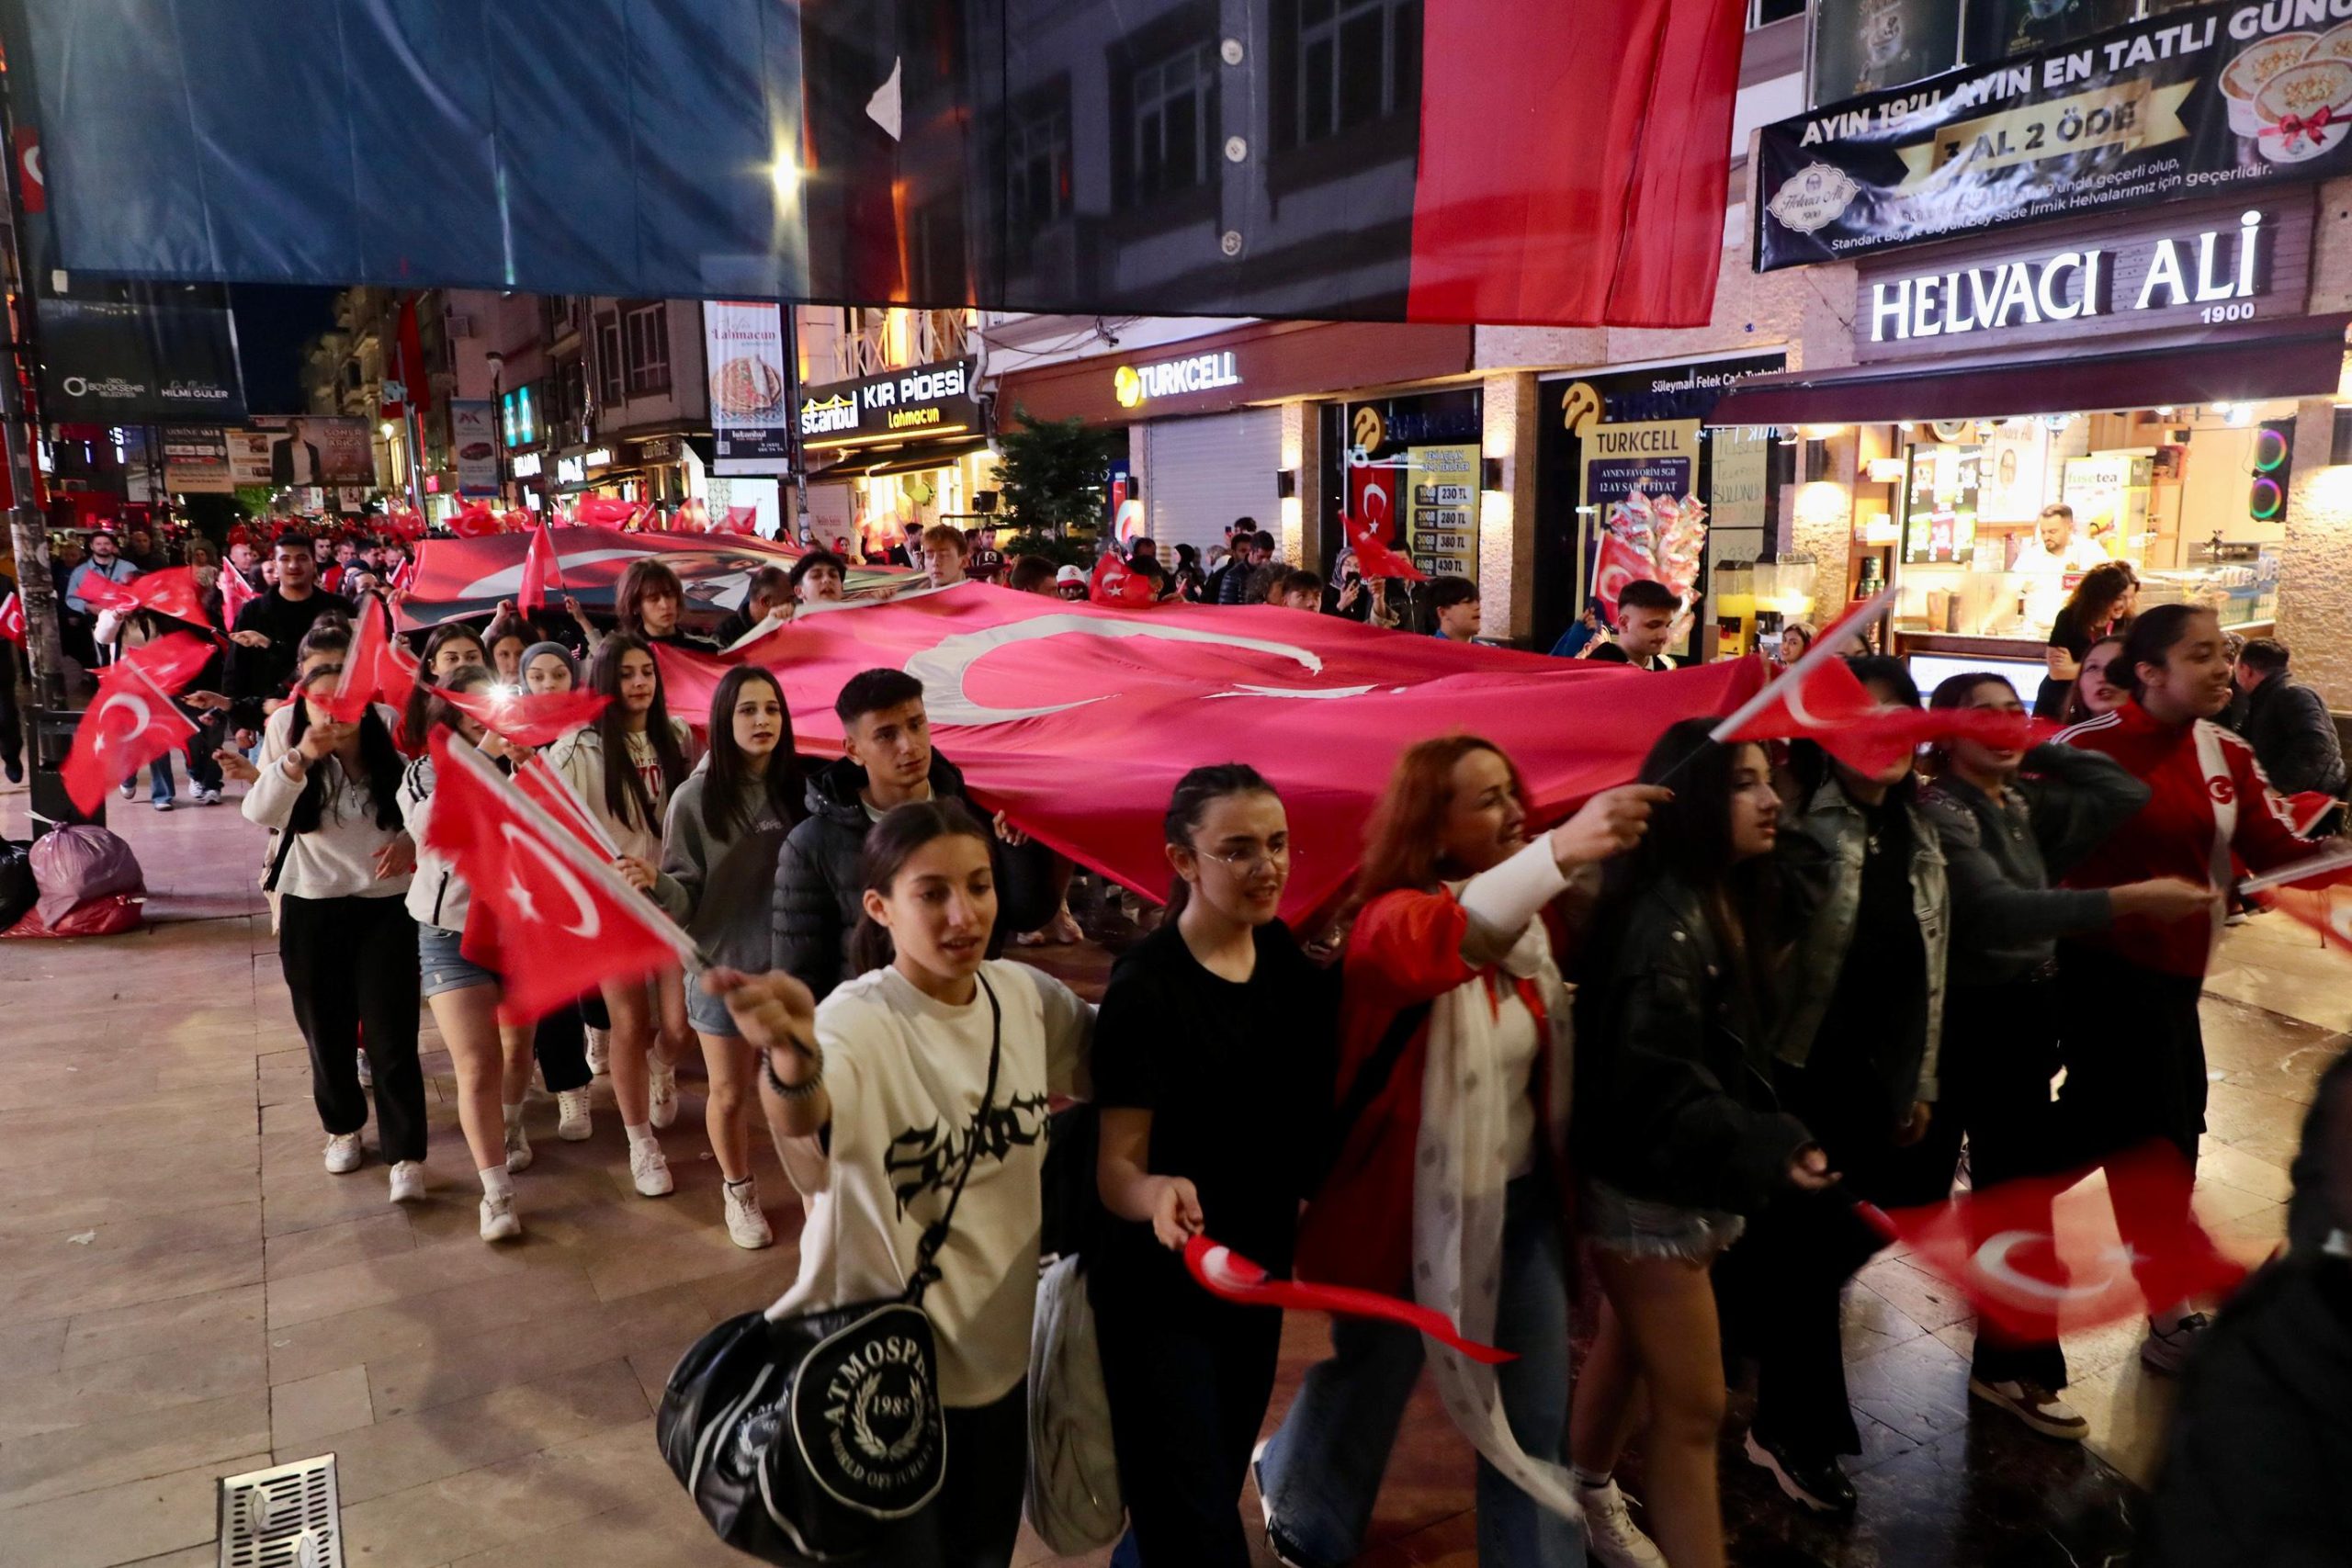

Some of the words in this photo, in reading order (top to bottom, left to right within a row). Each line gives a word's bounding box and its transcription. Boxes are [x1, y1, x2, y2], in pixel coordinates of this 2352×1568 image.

[1800, 107, 1871, 147] AYIN
[1951, 66, 2031, 108] AYIN
[2042, 50, 2093, 88] EN
[2104, 17, 2217, 72] TATLI
[1970, 130, 2016, 162] AL
[2025, 122, 2045, 150] 2
[2056, 100, 2138, 142] ÖDE
[2097, 164, 2145, 188] geçerli
[2148, 158, 2179, 175] olup,
[1831, 231, 1882, 251] Standart
[1995, 205, 2028, 221] Sade
[2030, 197, 2066, 216] İrmik
[2069, 184, 2156, 209] Helvalarımız
[2158, 174, 2181, 192] için
[2186, 163, 2273, 187] geçerlidir.
[1871, 250, 2101, 343] HELVACI
[2134, 210, 2262, 310] ALİ
[2199, 302, 2256, 324] 1900
[864, 382, 896, 410] KIR
[900, 361, 965, 403] PİDESİ
[1137, 352, 1238, 399] TURKCELL
[1652, 378, 1694, 394] Süleyman
[1696, 374, 1721, 389] Felek
[888, 407, 940, 429] Lahmacun
[1597, 430, 1679, 453] TURKCELL
[1442, 488, 1457, 499] 230
[1458, 488, 1467, 499] TL
[1441, 513, 1456, 524] 280
[1458, 513, 1466, 524] TL
[1441, 536, 1455, 547] 380
[1457, 536, 1465, 547] TL
[1438, 559, 1453, 570] 430
[1454, 560, 1463, 571] TL
